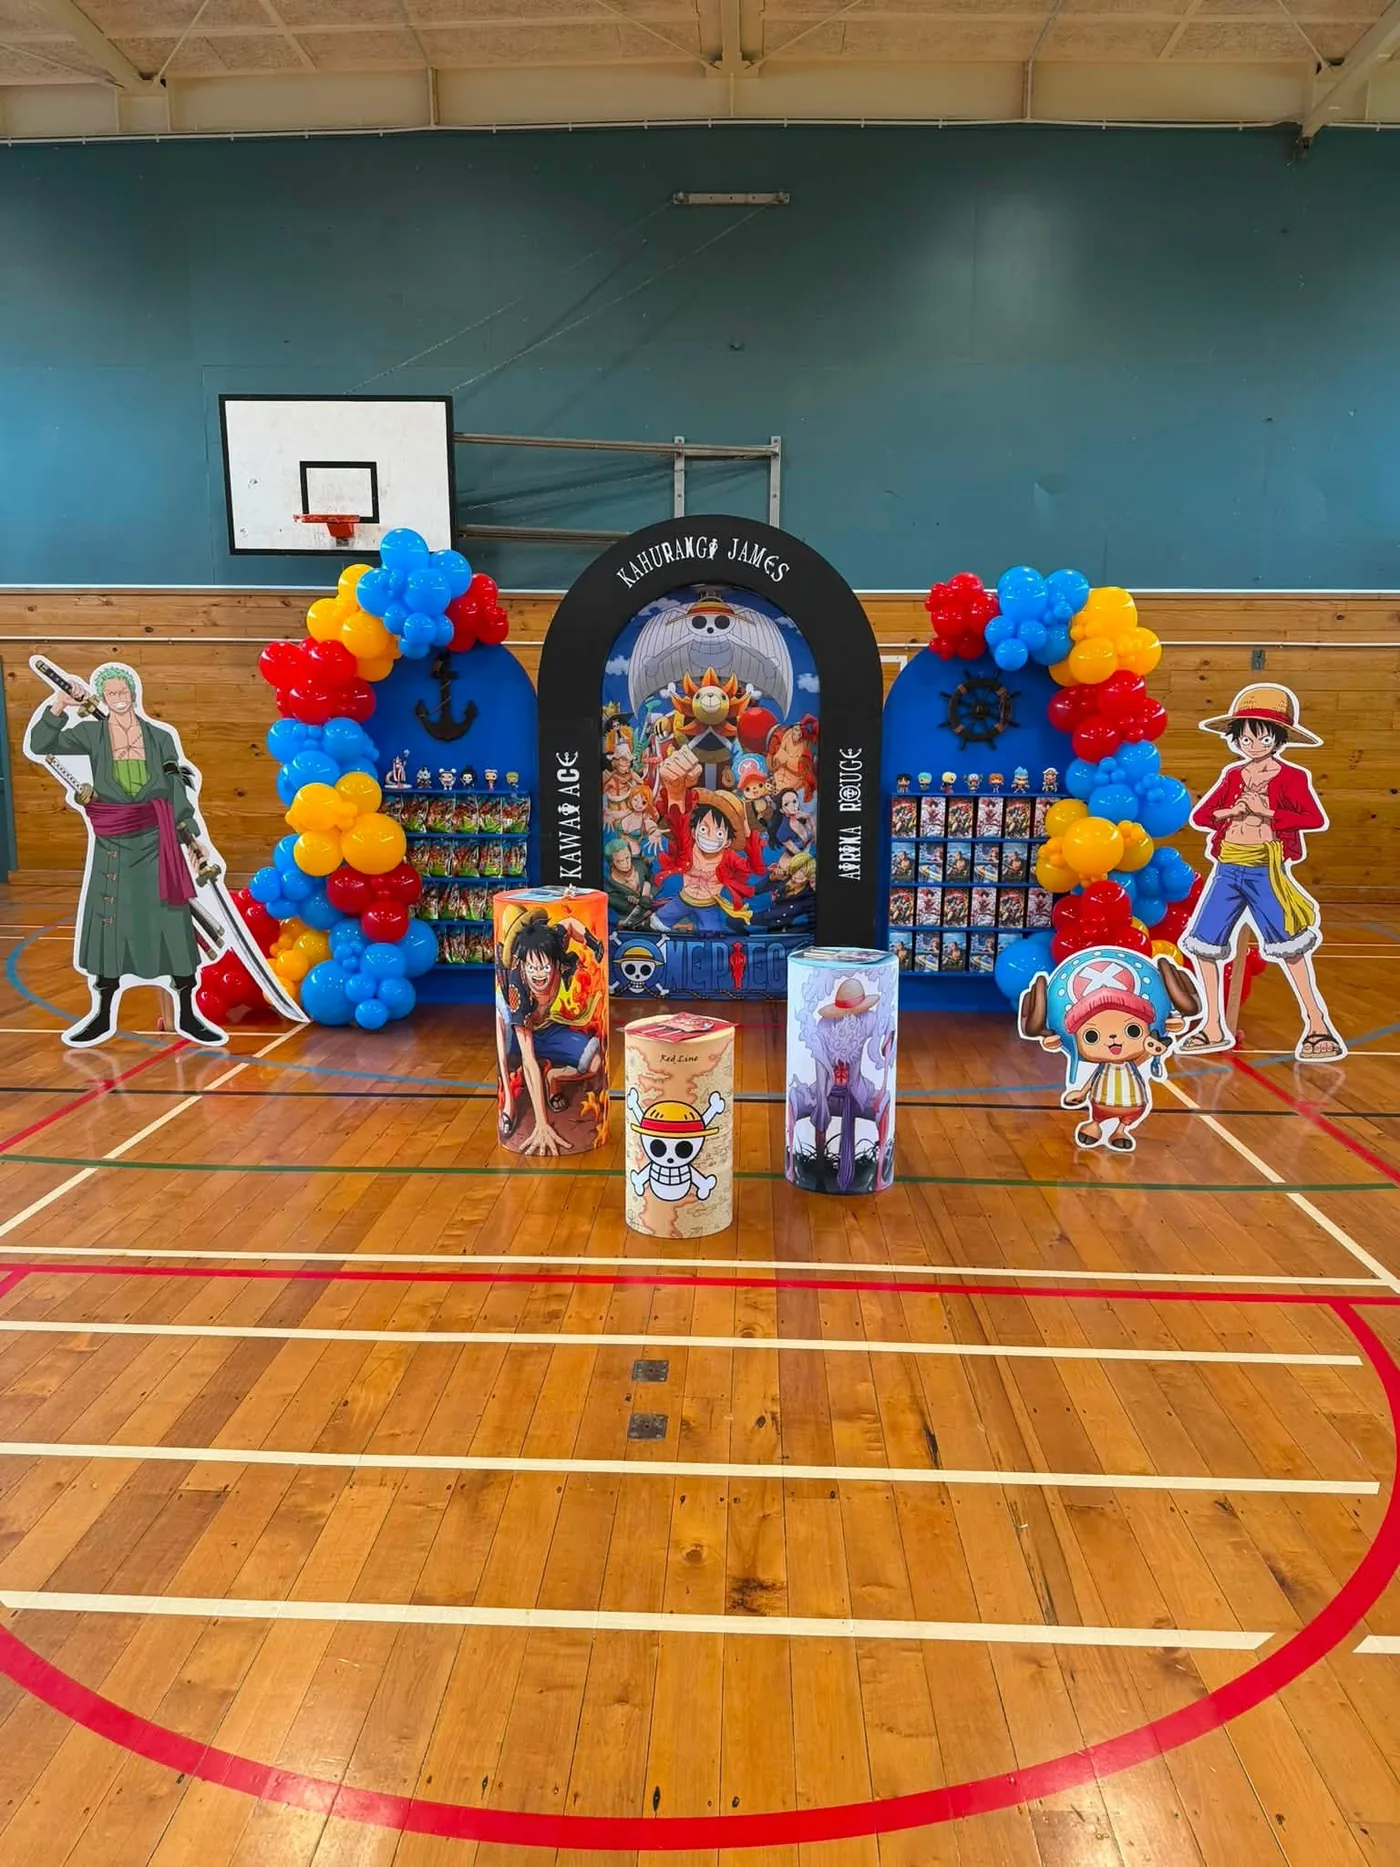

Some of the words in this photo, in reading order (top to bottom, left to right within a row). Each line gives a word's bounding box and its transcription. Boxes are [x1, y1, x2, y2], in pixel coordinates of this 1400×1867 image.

[616, 536, 719, 589] KAHURANGI
[727, 537, 791, 583] JAMES
[555, 750, 580, 798] ACE
[837, 747, 863, 812] ROUGE
[557, 802, 583, 880] KAWAI
[660, 1054, 676, 1064] Red
[677, 1054, 698, 1062] Line
